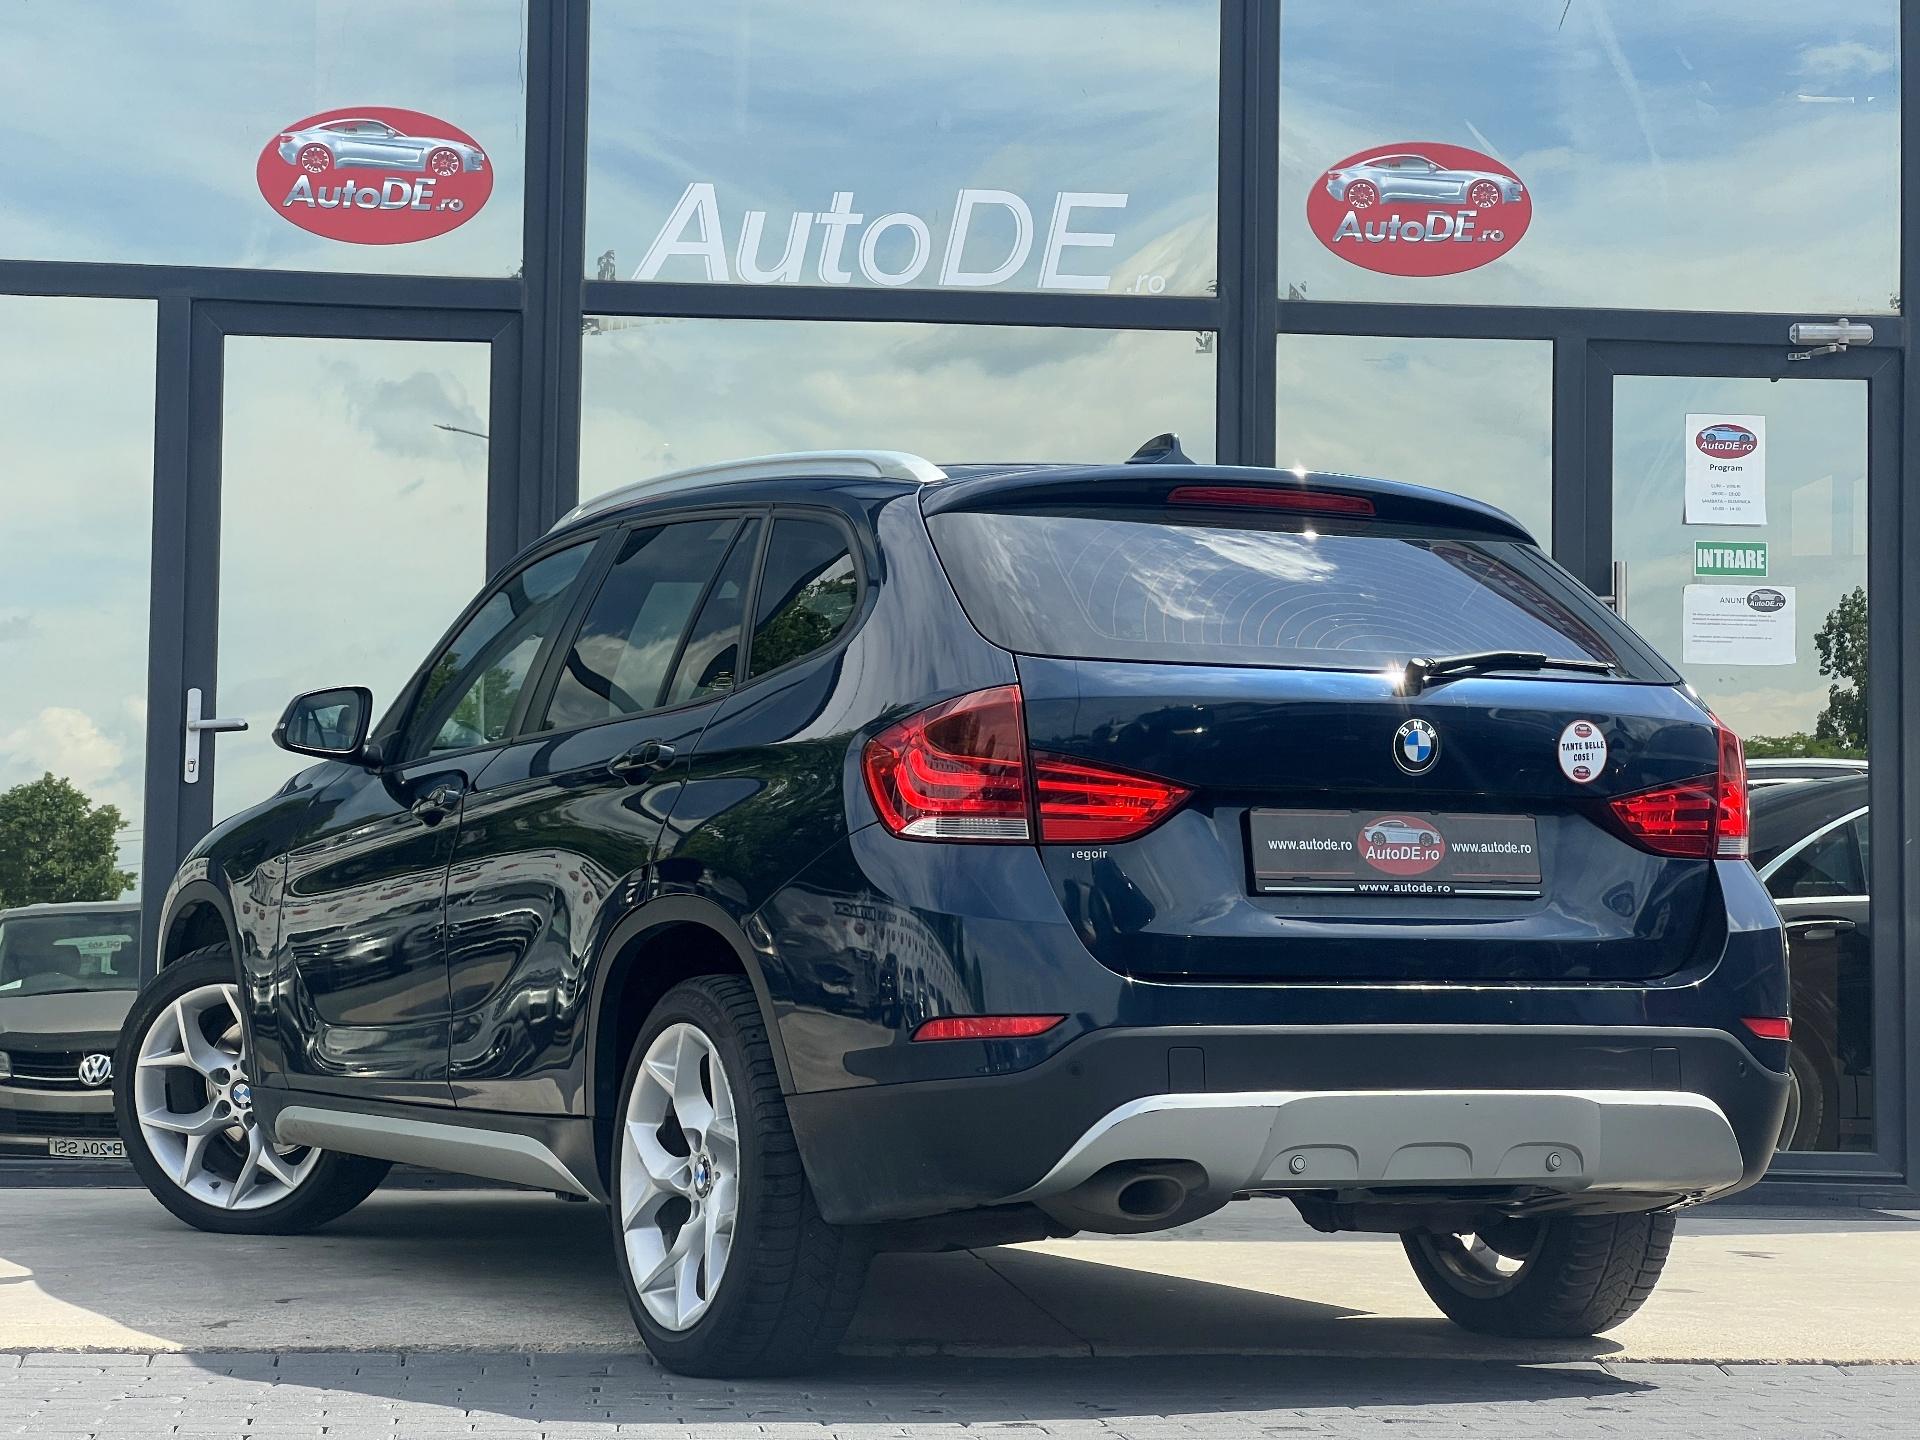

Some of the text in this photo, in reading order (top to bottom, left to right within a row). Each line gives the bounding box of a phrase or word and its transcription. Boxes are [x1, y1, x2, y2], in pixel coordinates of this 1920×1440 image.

[1700, 441, 1754, 451] AutoDE.ro
[1709, 464, 1743, 472] Program
[1697, 548, 1765, 569] INTRARE
[1399, 721, 1436, 738] BMW
[1562, 741, 1604, 751] TANTE BELLE
[1268, 838, 1352, 851] www.autode.ro
[1451, 842, 1532, 854] www.autode.ro
[1365, 845, 1440, 861] AutoDE.ro
[1358, 883, 1451, 893] www.autode.ro
